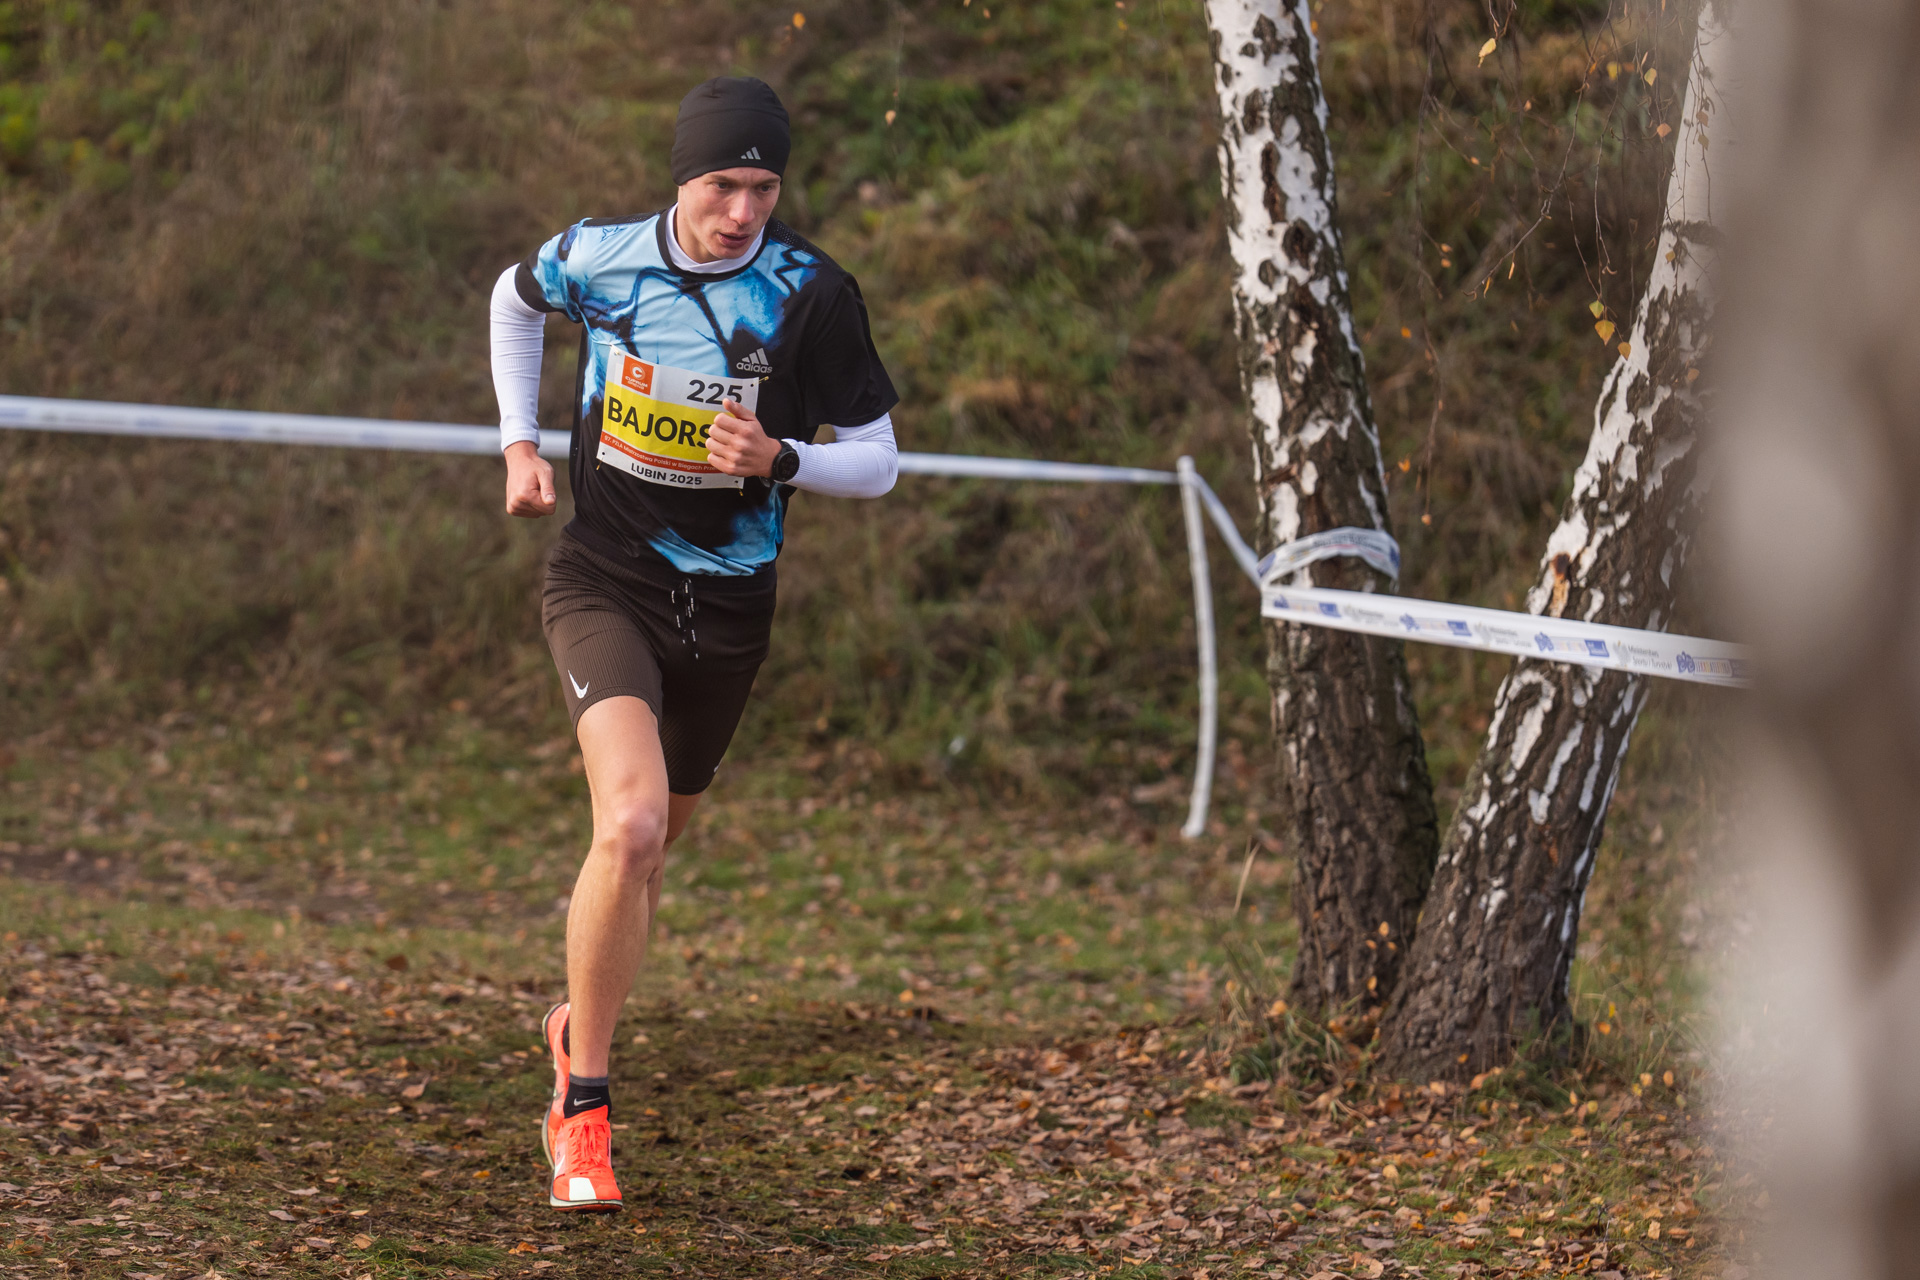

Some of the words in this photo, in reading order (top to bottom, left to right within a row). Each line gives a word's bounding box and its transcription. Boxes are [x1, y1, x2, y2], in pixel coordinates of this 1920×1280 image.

[736, 362, 773, 374] adidas
[686, 379, 743, 405] 225
[631, 462, 667, 481] LUBIN
[669, 473, 702, 485] 2025
[653, 458, 671, 466] Polski
[677, 462, 703, 471] Biegach
